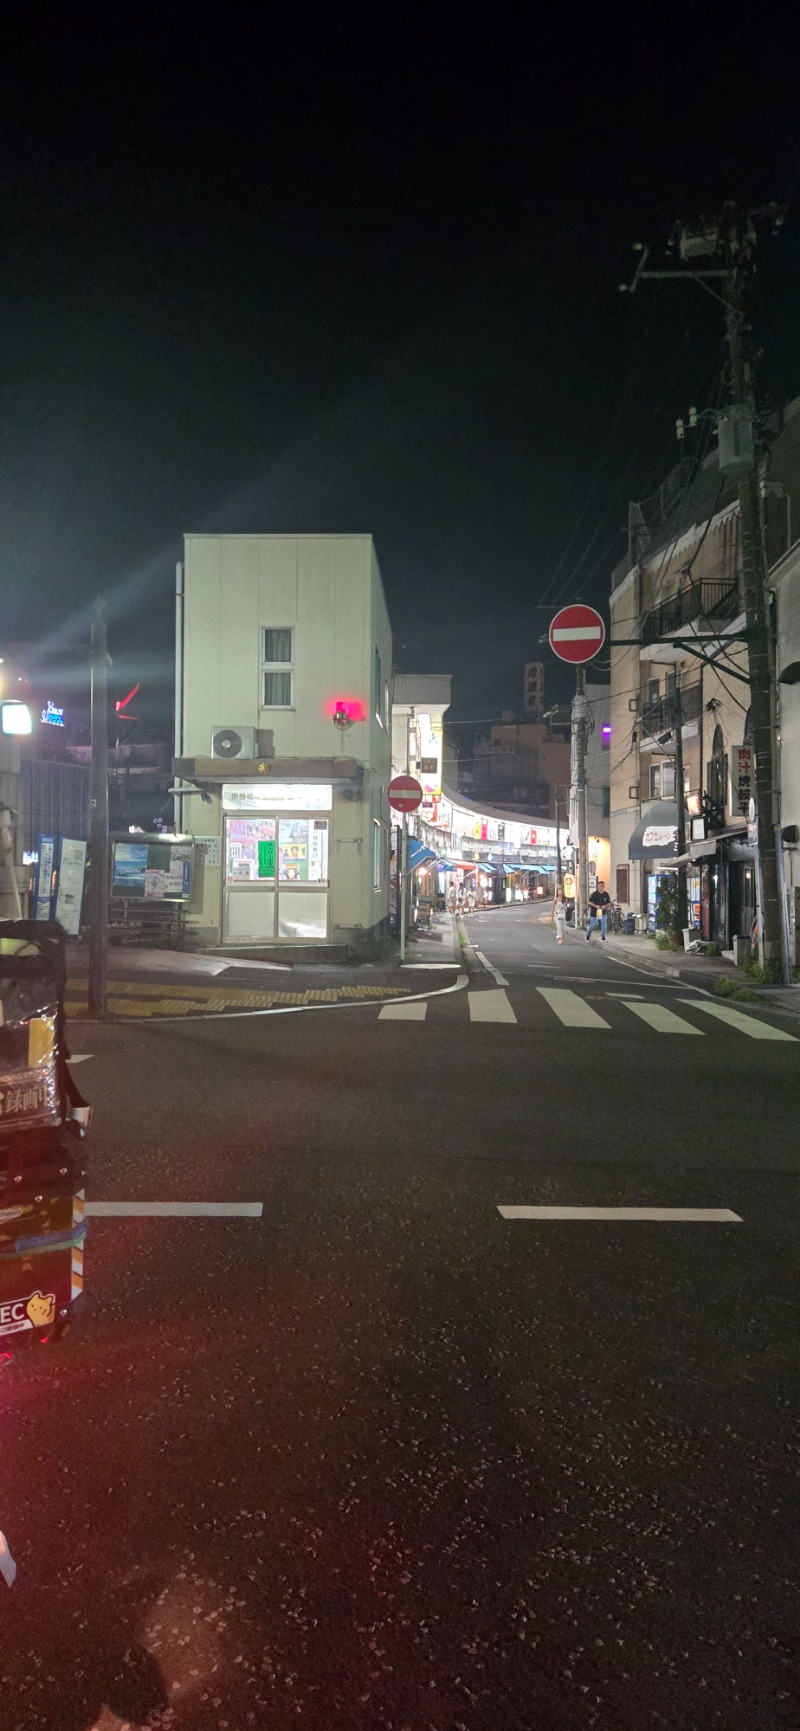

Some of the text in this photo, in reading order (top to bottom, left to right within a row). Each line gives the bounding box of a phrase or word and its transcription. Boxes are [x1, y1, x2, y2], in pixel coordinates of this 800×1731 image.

[738, 748, 751, 815] 肉汁焼餃子
[0, 1086, 52, 1114] 録画中
